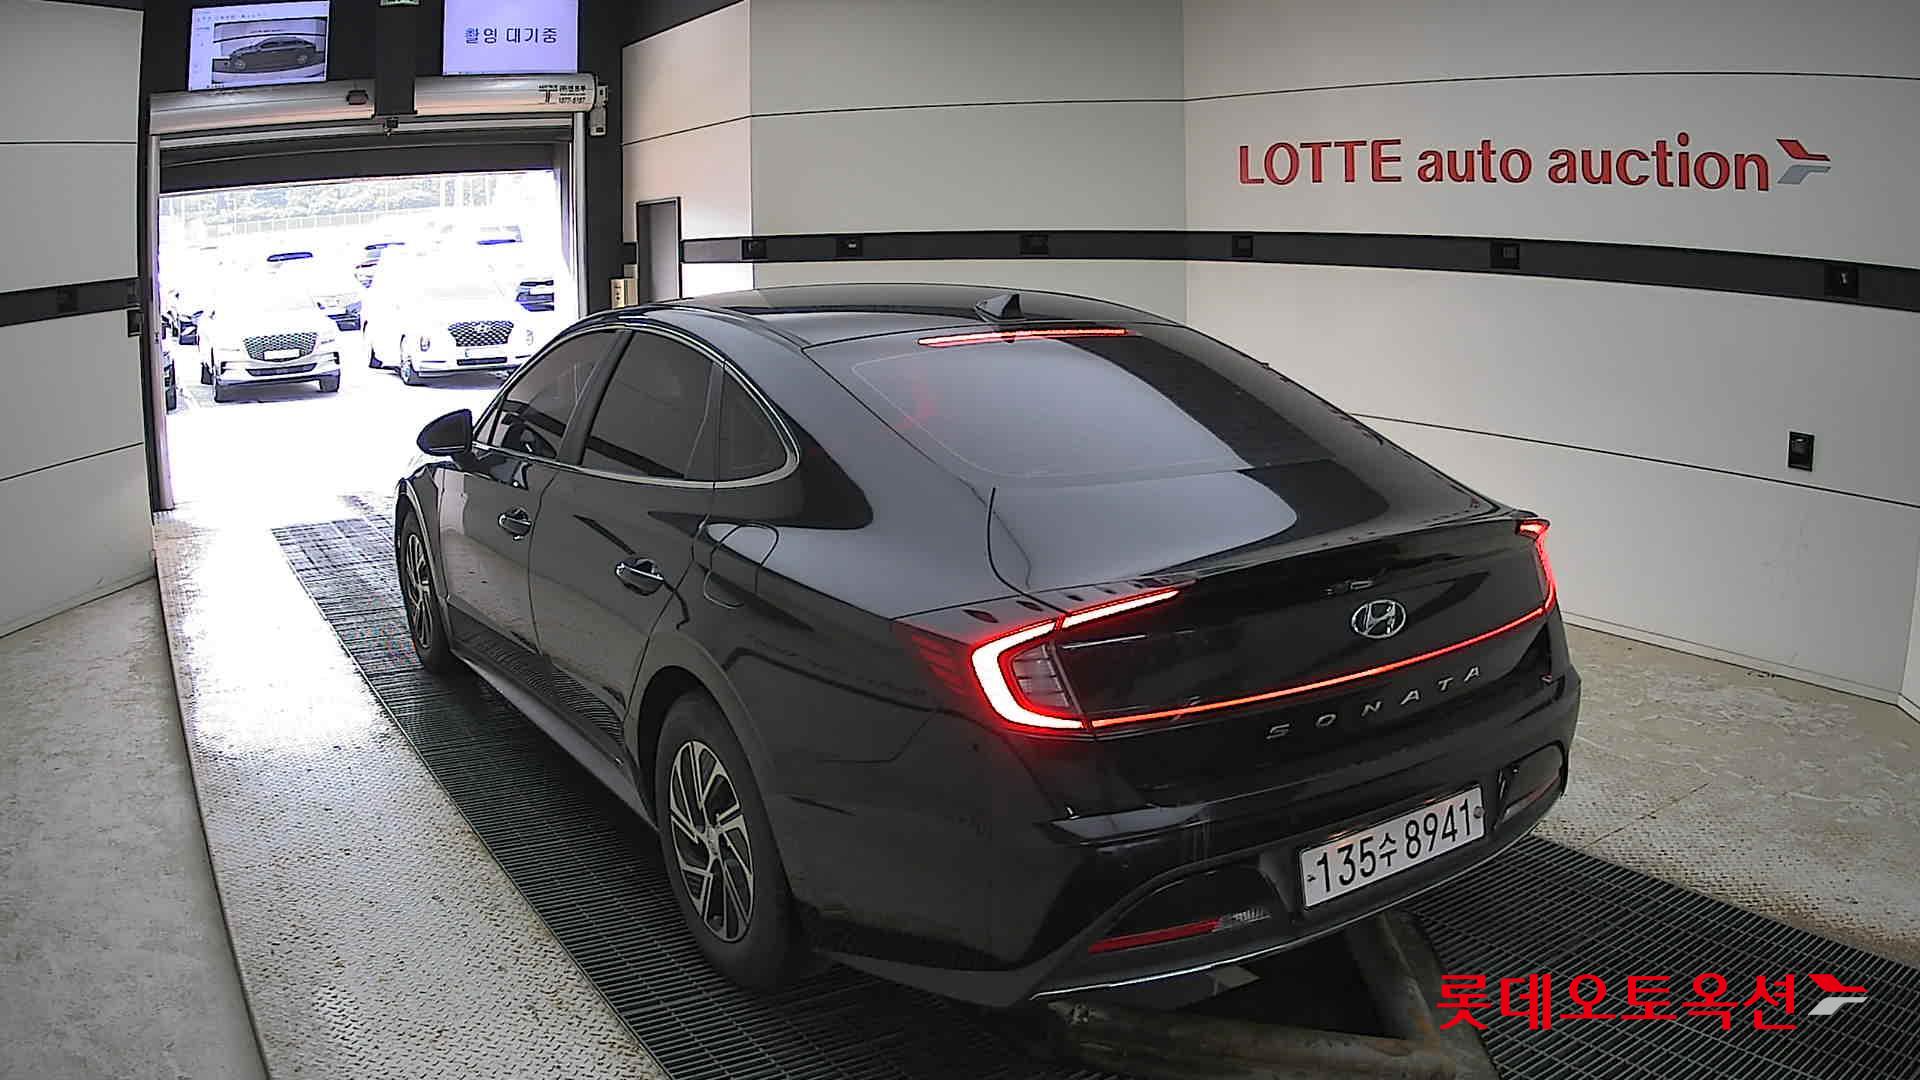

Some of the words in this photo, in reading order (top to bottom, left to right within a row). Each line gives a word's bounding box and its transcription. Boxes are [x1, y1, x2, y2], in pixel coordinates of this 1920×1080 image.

[1238, 138, 1402, 186] LOTTE
[1417, 140, 1532, 184] auto
[1548, 132, 1770, 191] auction
[1266, 665, 1481, 740] SONATA
